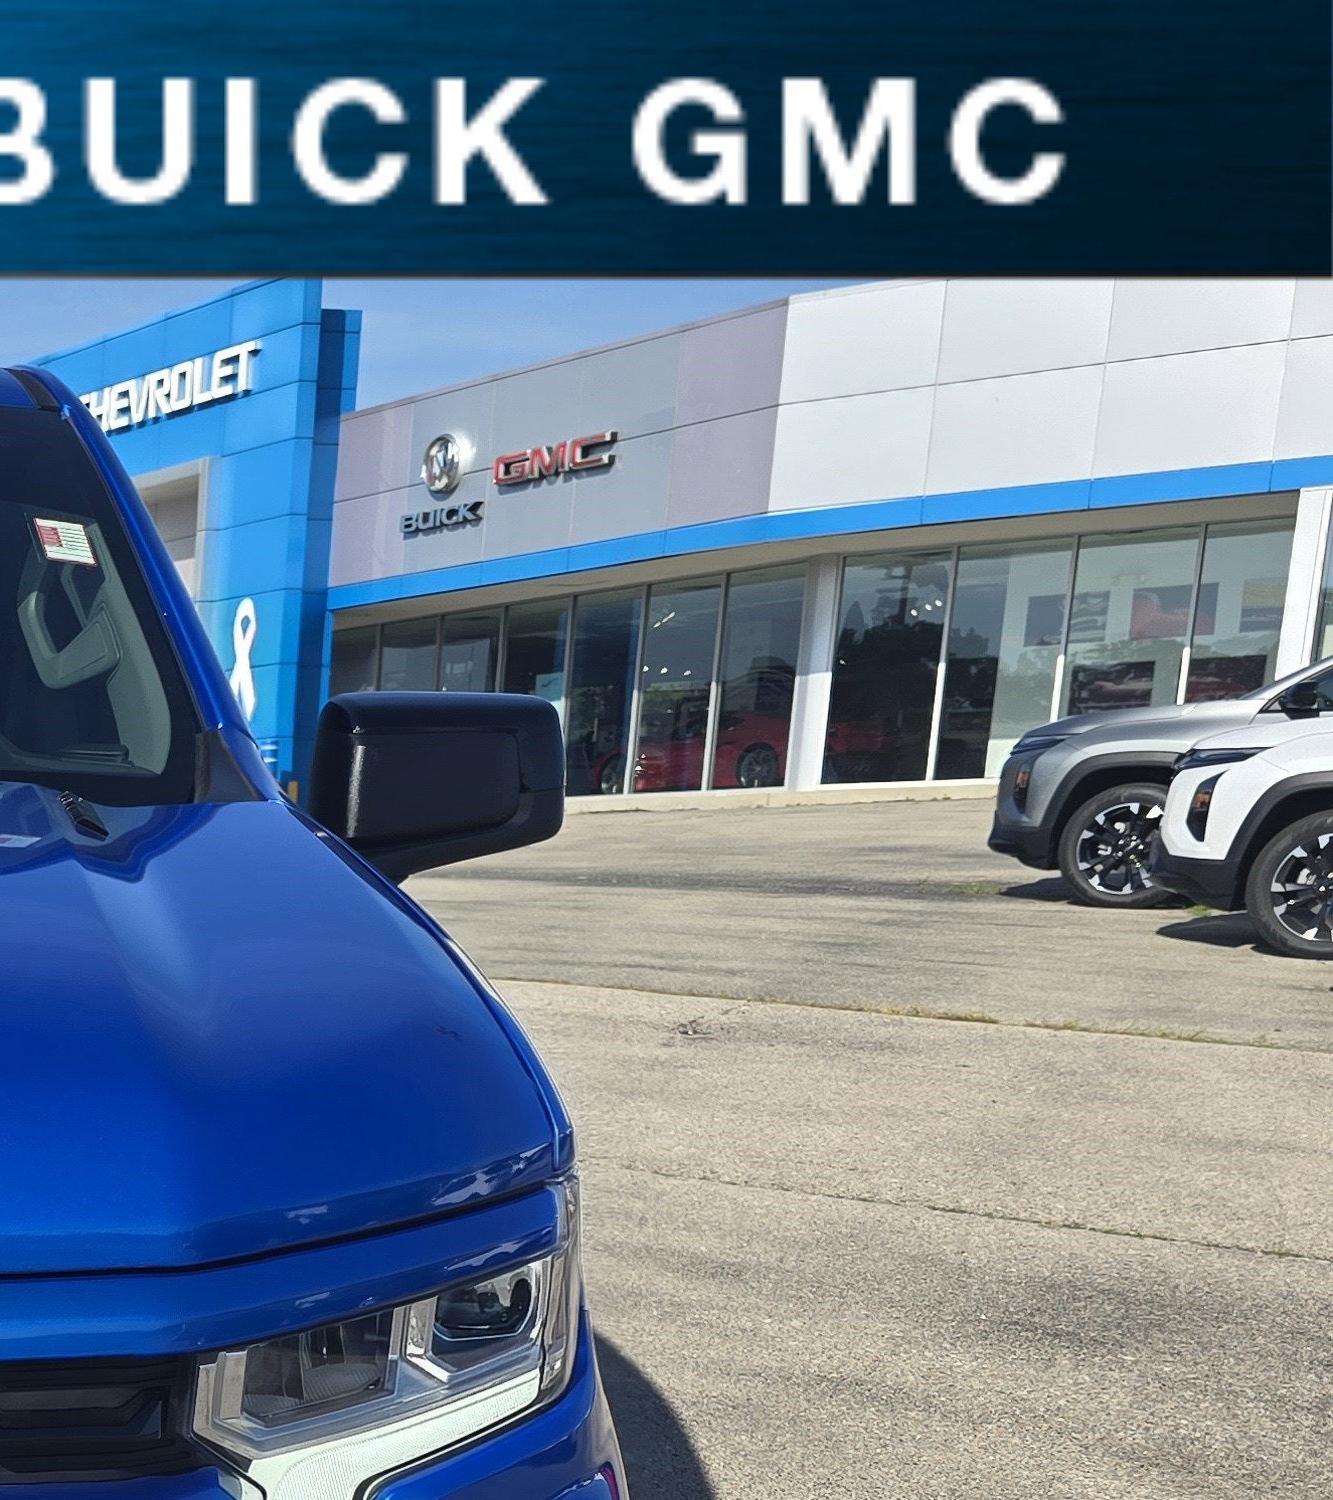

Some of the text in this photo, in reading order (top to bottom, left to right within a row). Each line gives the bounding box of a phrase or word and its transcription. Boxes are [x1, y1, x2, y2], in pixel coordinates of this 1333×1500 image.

[78, 341, 262, 433] HEVROLET
[492, 431, 619, 486] GMC
[400, 501, 483, 534] BUICK
